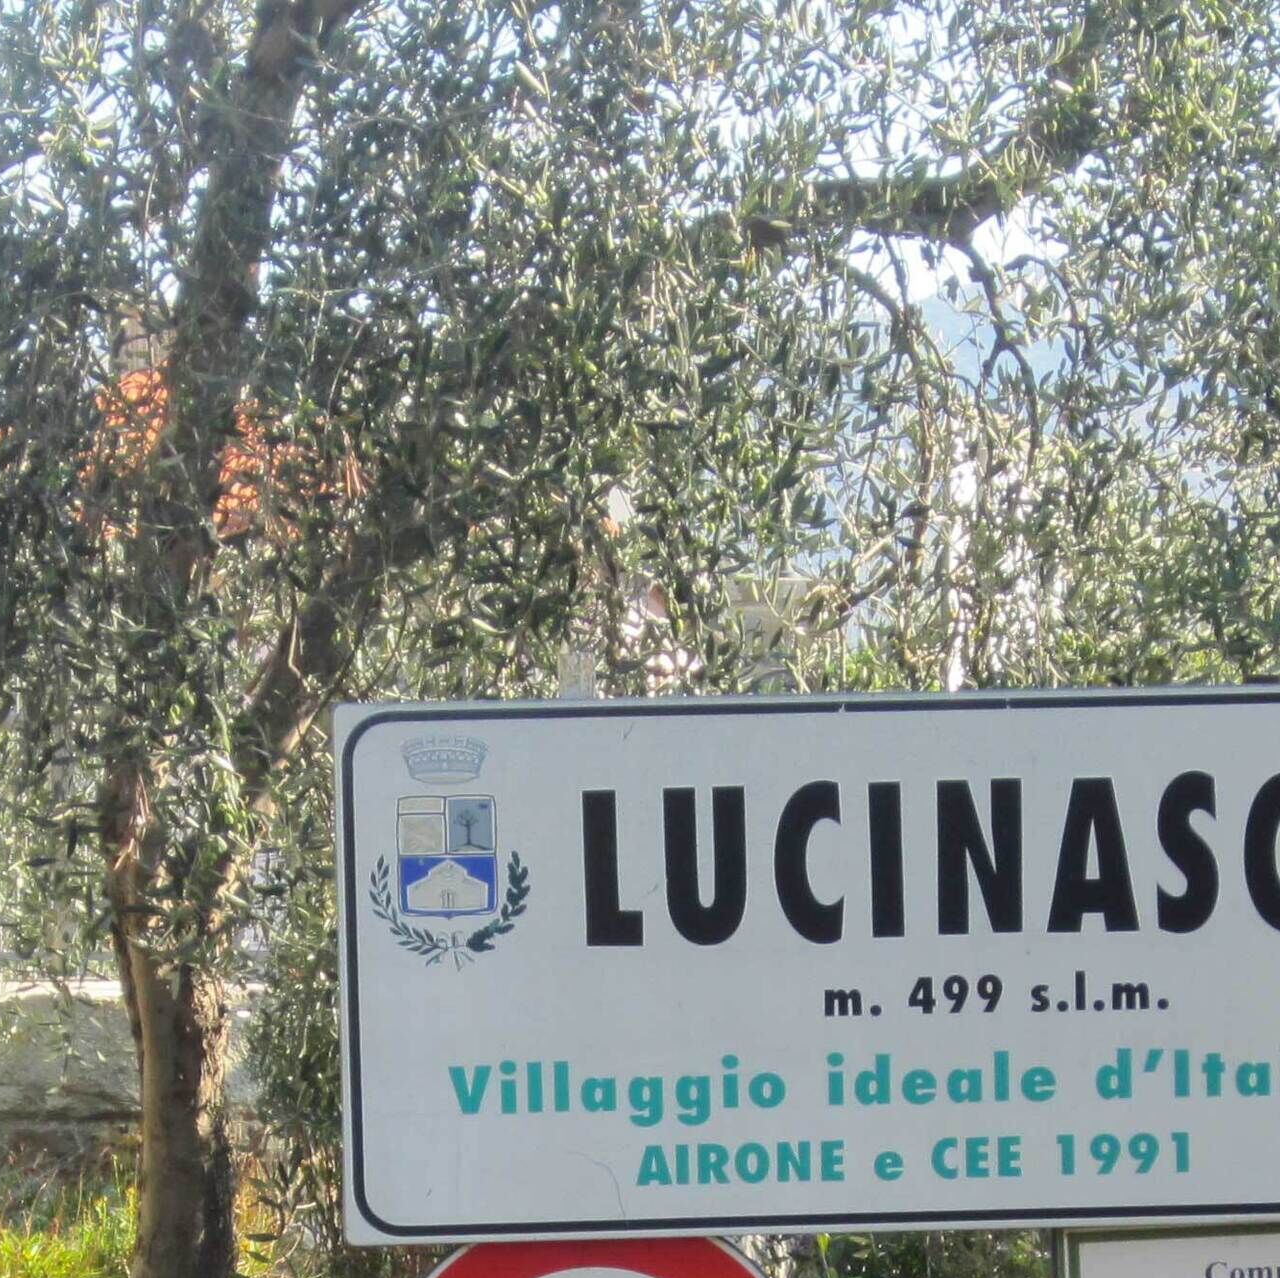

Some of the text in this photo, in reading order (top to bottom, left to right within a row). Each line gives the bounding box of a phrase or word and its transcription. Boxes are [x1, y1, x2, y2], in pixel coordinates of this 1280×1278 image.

[824, 970, 1170, 1017] m. 499 s.l.m.
[449, 1056, 785, 1127] Villaggio
[827, 1051, 1056, 1105] ideale
[636, 1132, 1191, 1186] AIRONE e CEE 1991
